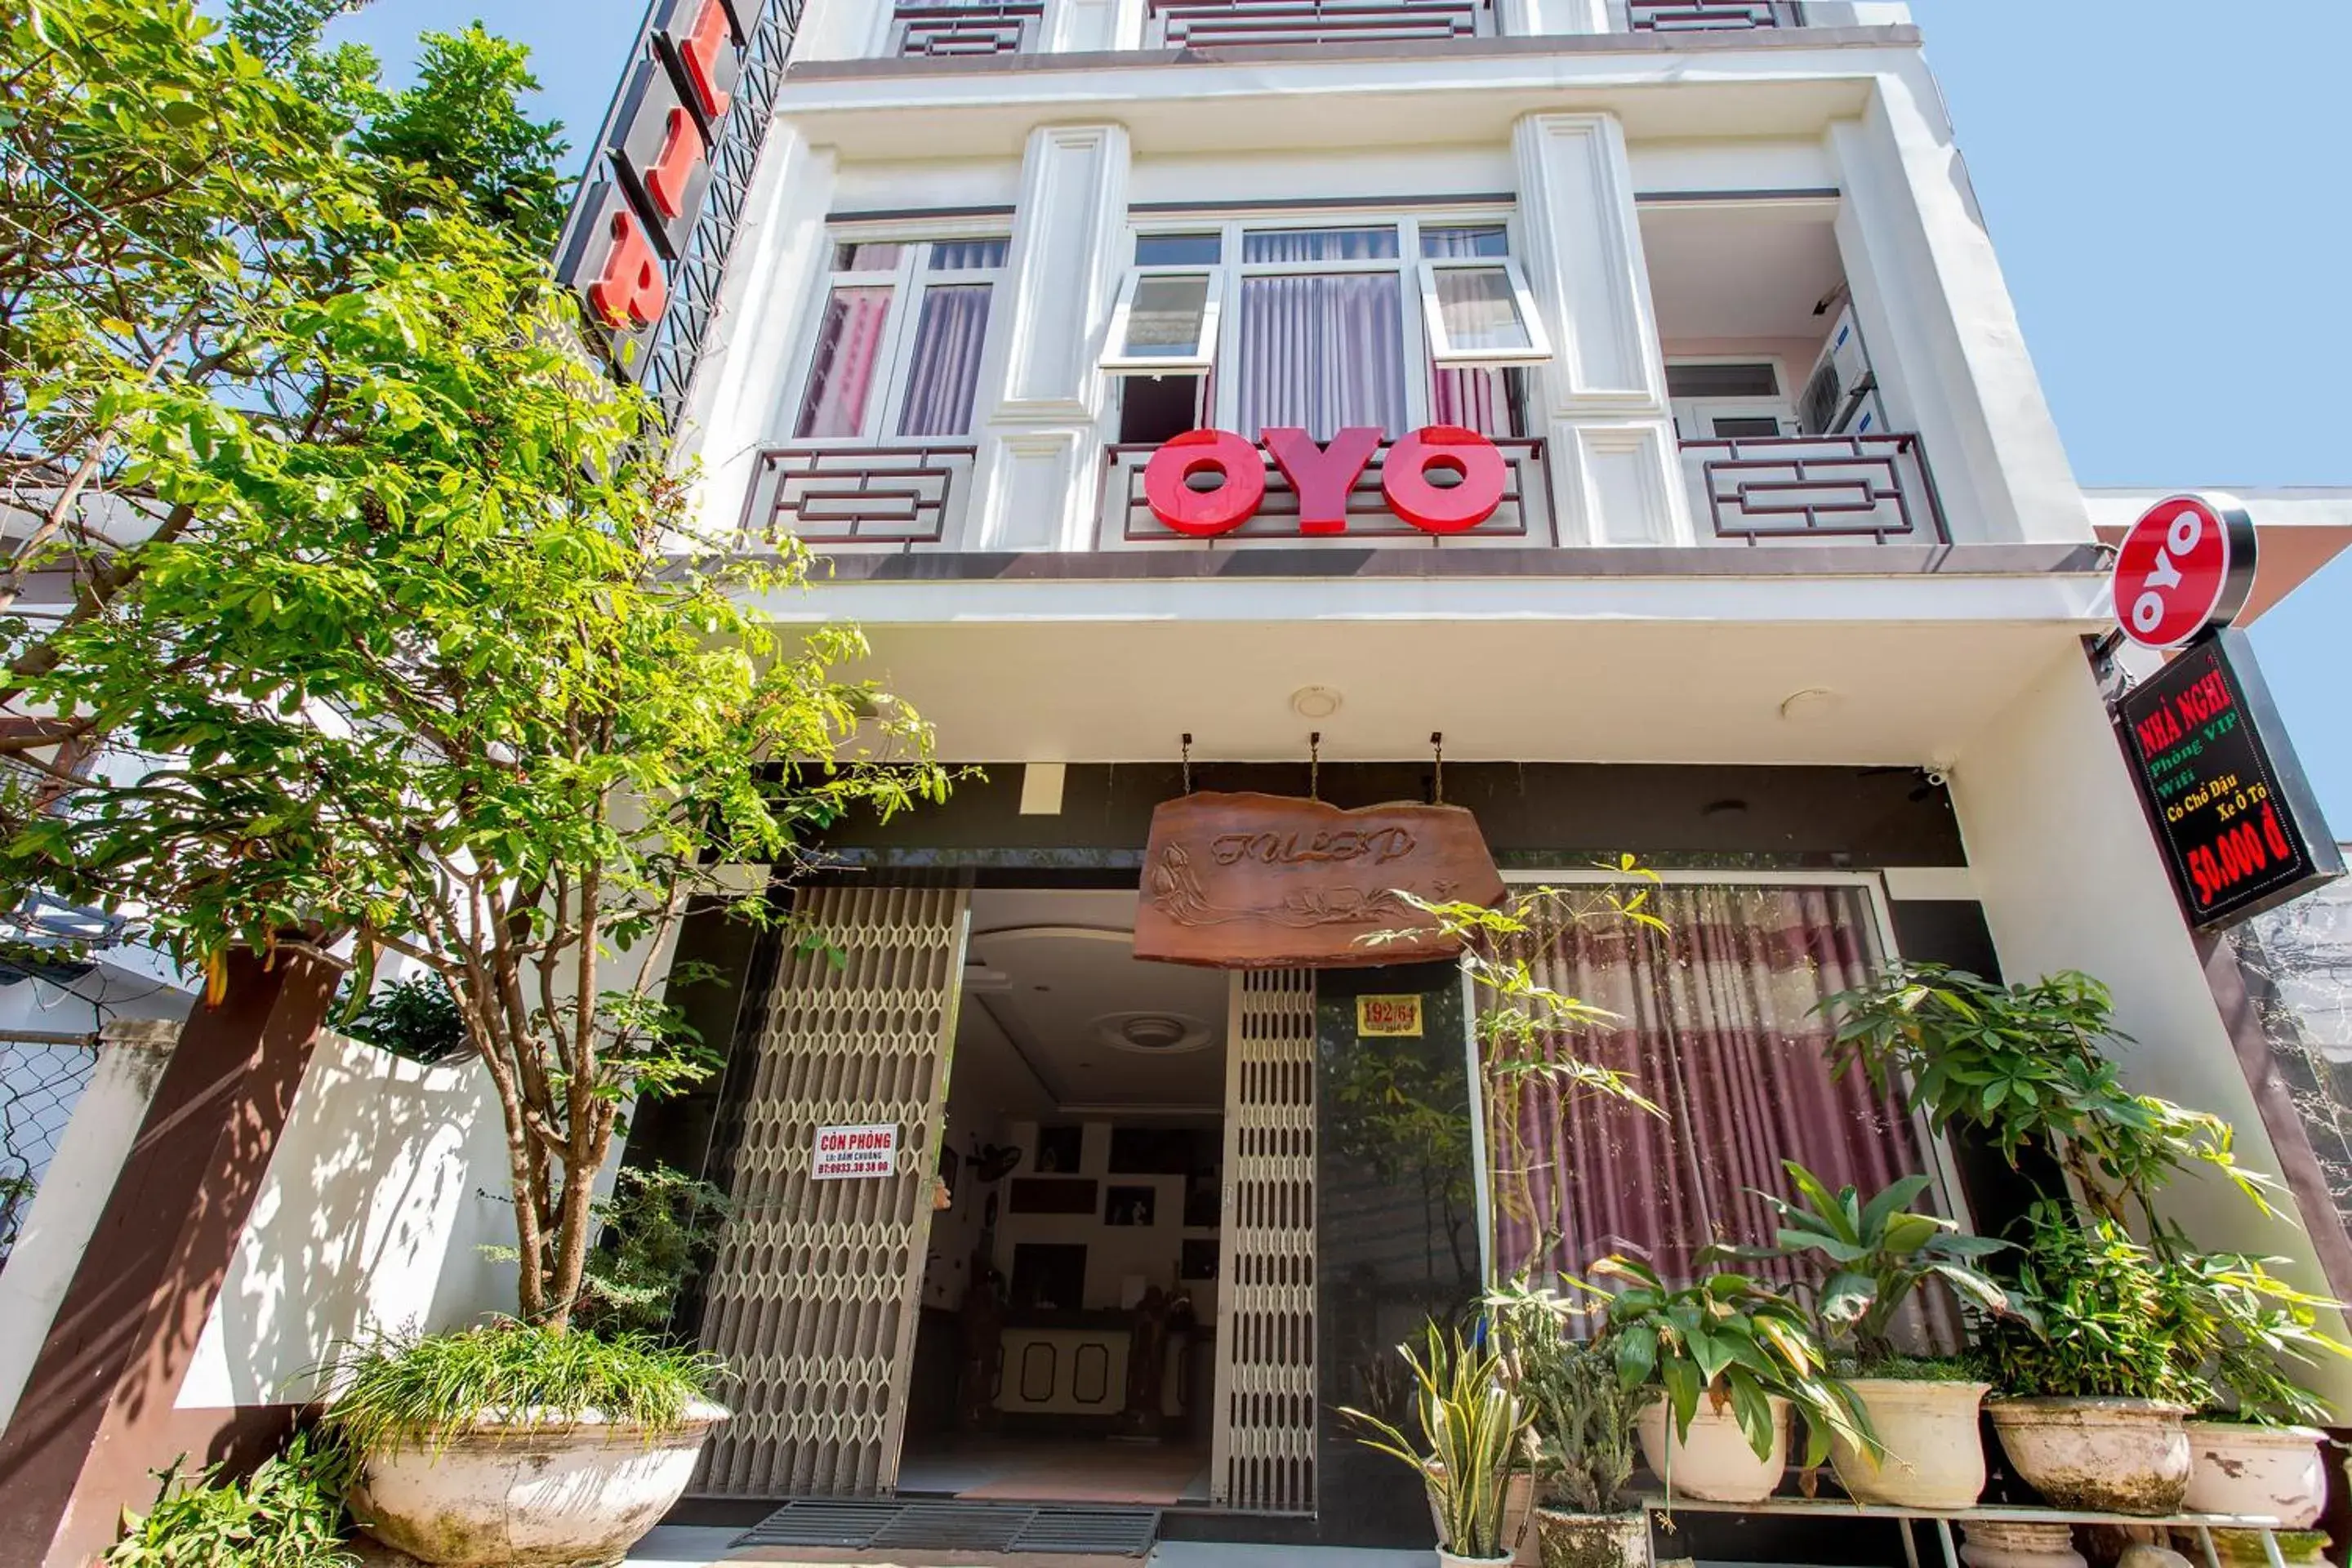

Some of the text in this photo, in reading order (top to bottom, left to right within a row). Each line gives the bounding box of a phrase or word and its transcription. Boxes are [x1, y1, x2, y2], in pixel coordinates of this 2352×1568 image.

[1143, 425, 1506, 535] OYO
[2132, 511, 2203, 633] OYO
[2203, 711, 2237, 741] VIP
[2157, 768, 2196, 798] Wifi
[2216, 782, 2266, 822] Xe Ô Tô
[2187, 821, 2265, 905] 50.000
